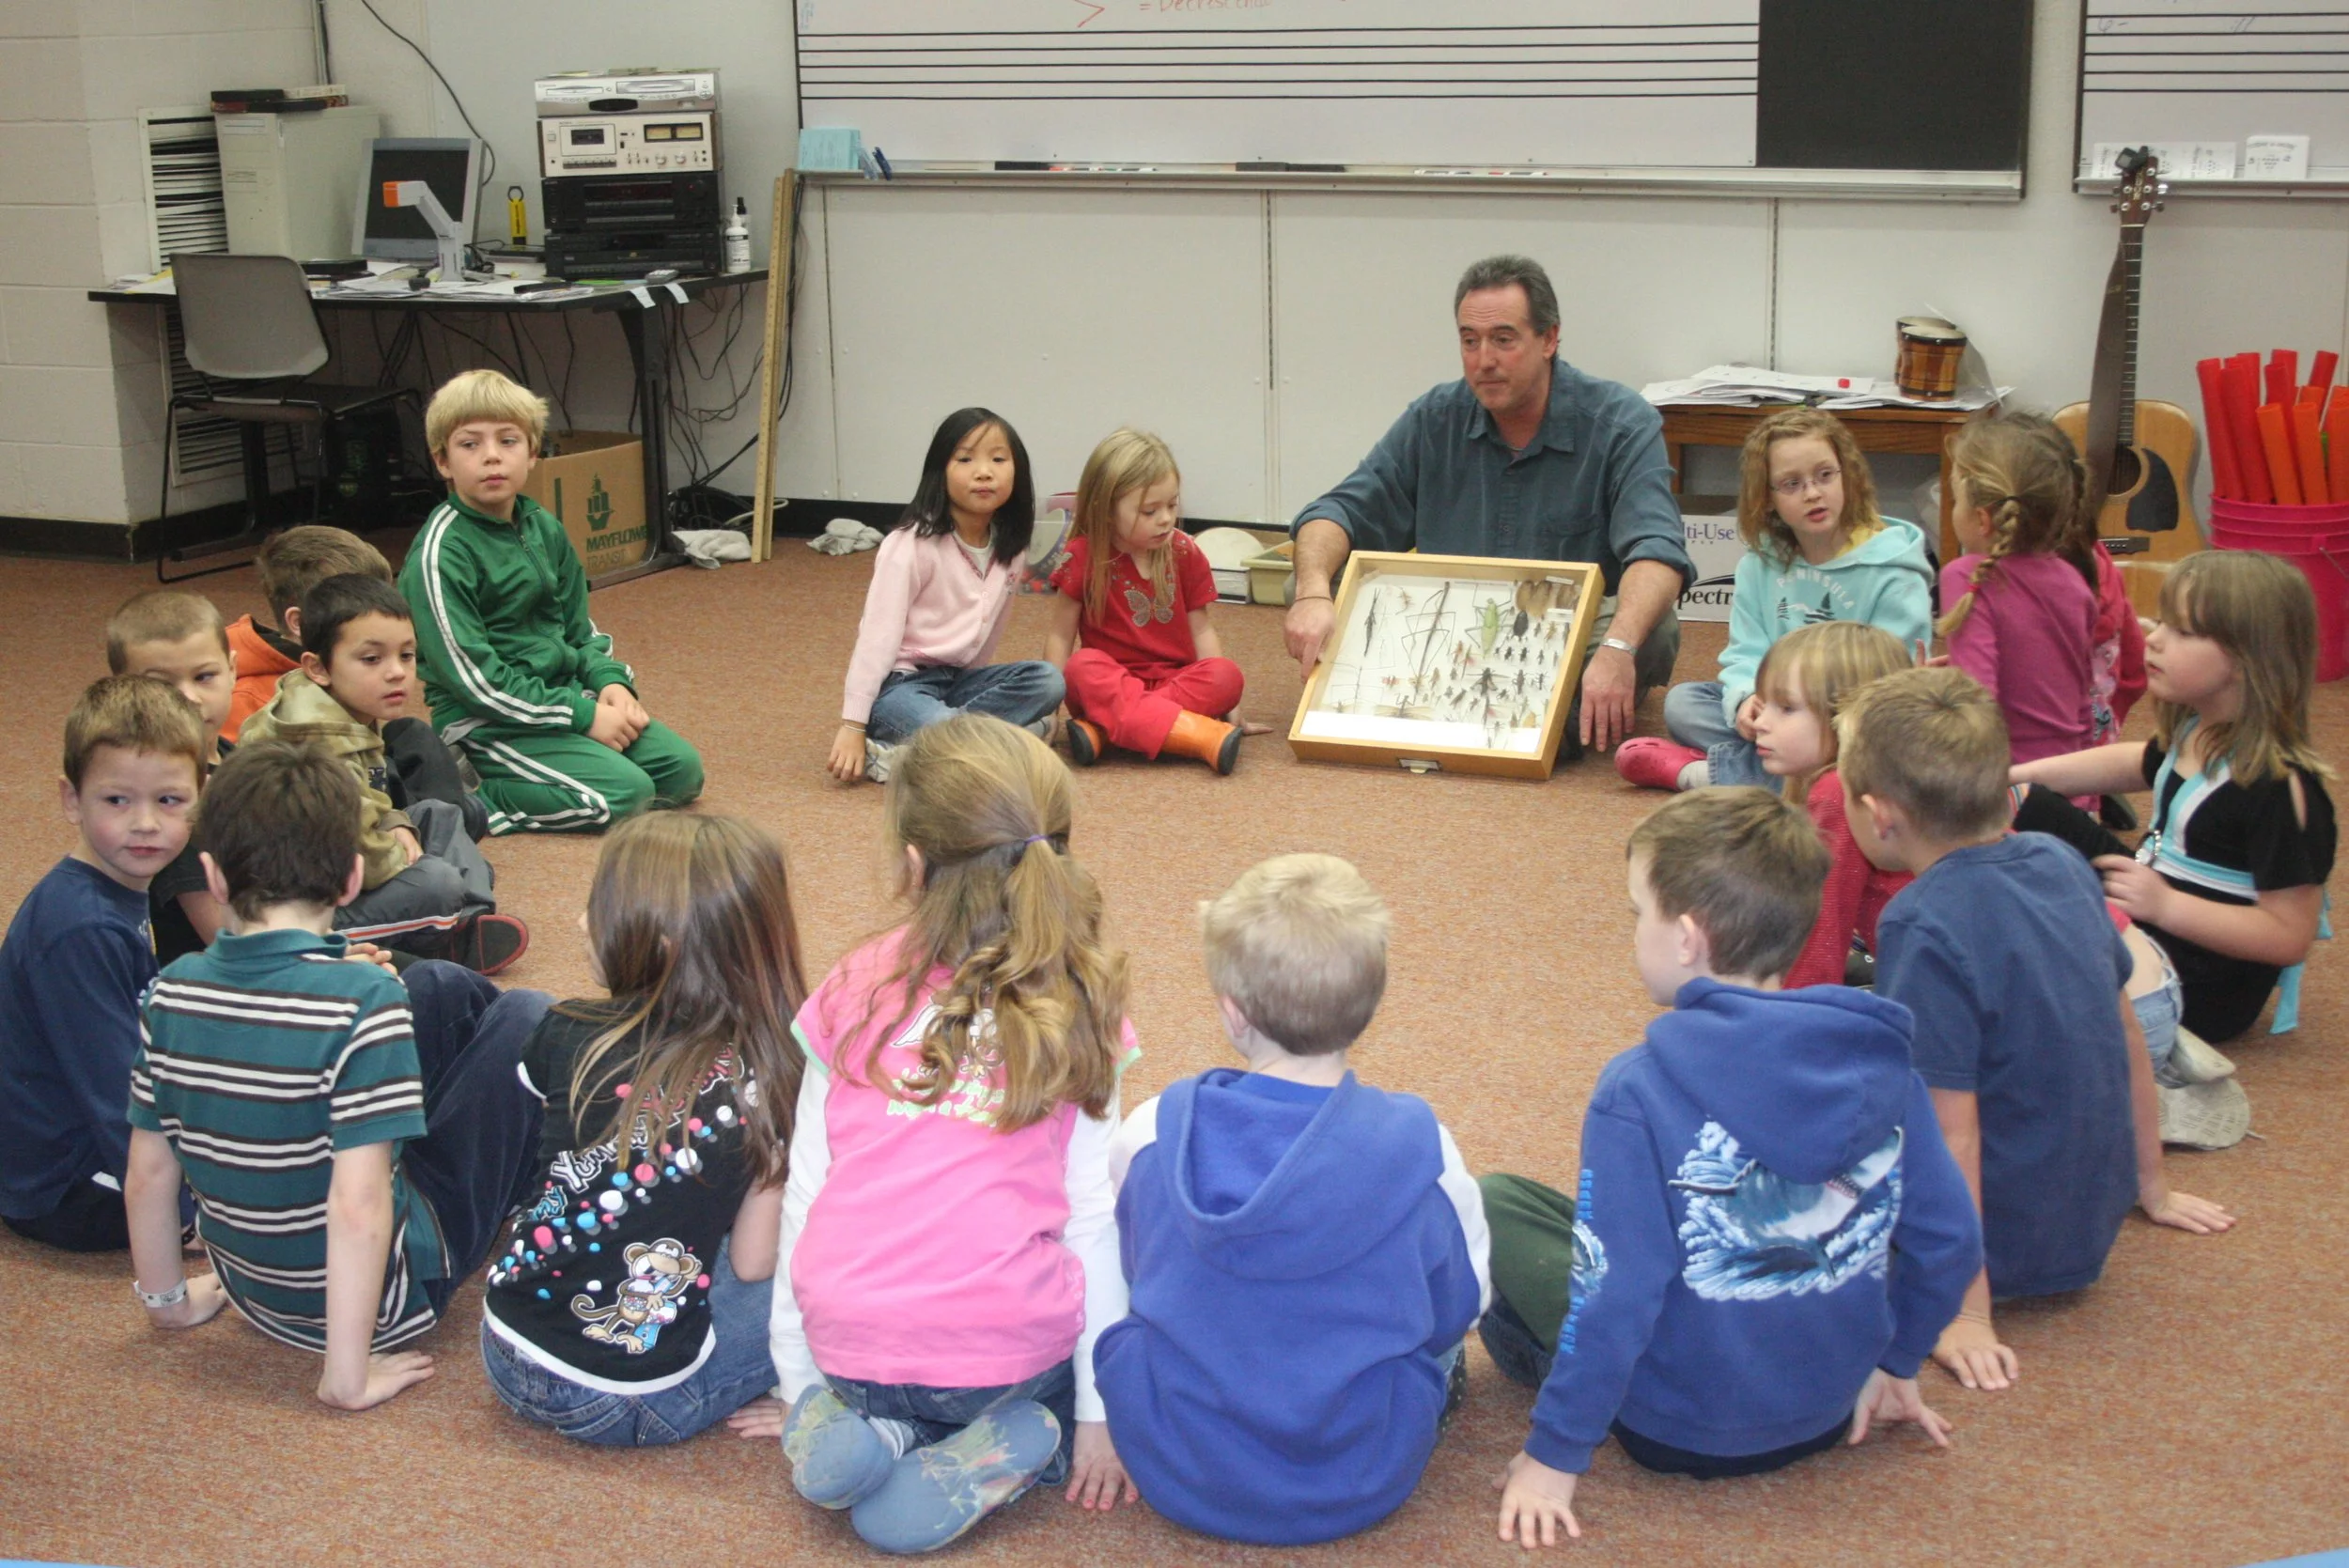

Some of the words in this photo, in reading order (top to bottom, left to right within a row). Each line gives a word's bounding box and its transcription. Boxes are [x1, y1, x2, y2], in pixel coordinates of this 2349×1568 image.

[586, 525, 647, 552] MAYFLOWE
[1682, 522, 1735, 540] ti-Use
[1677, 588, 1733, 610] pectr
